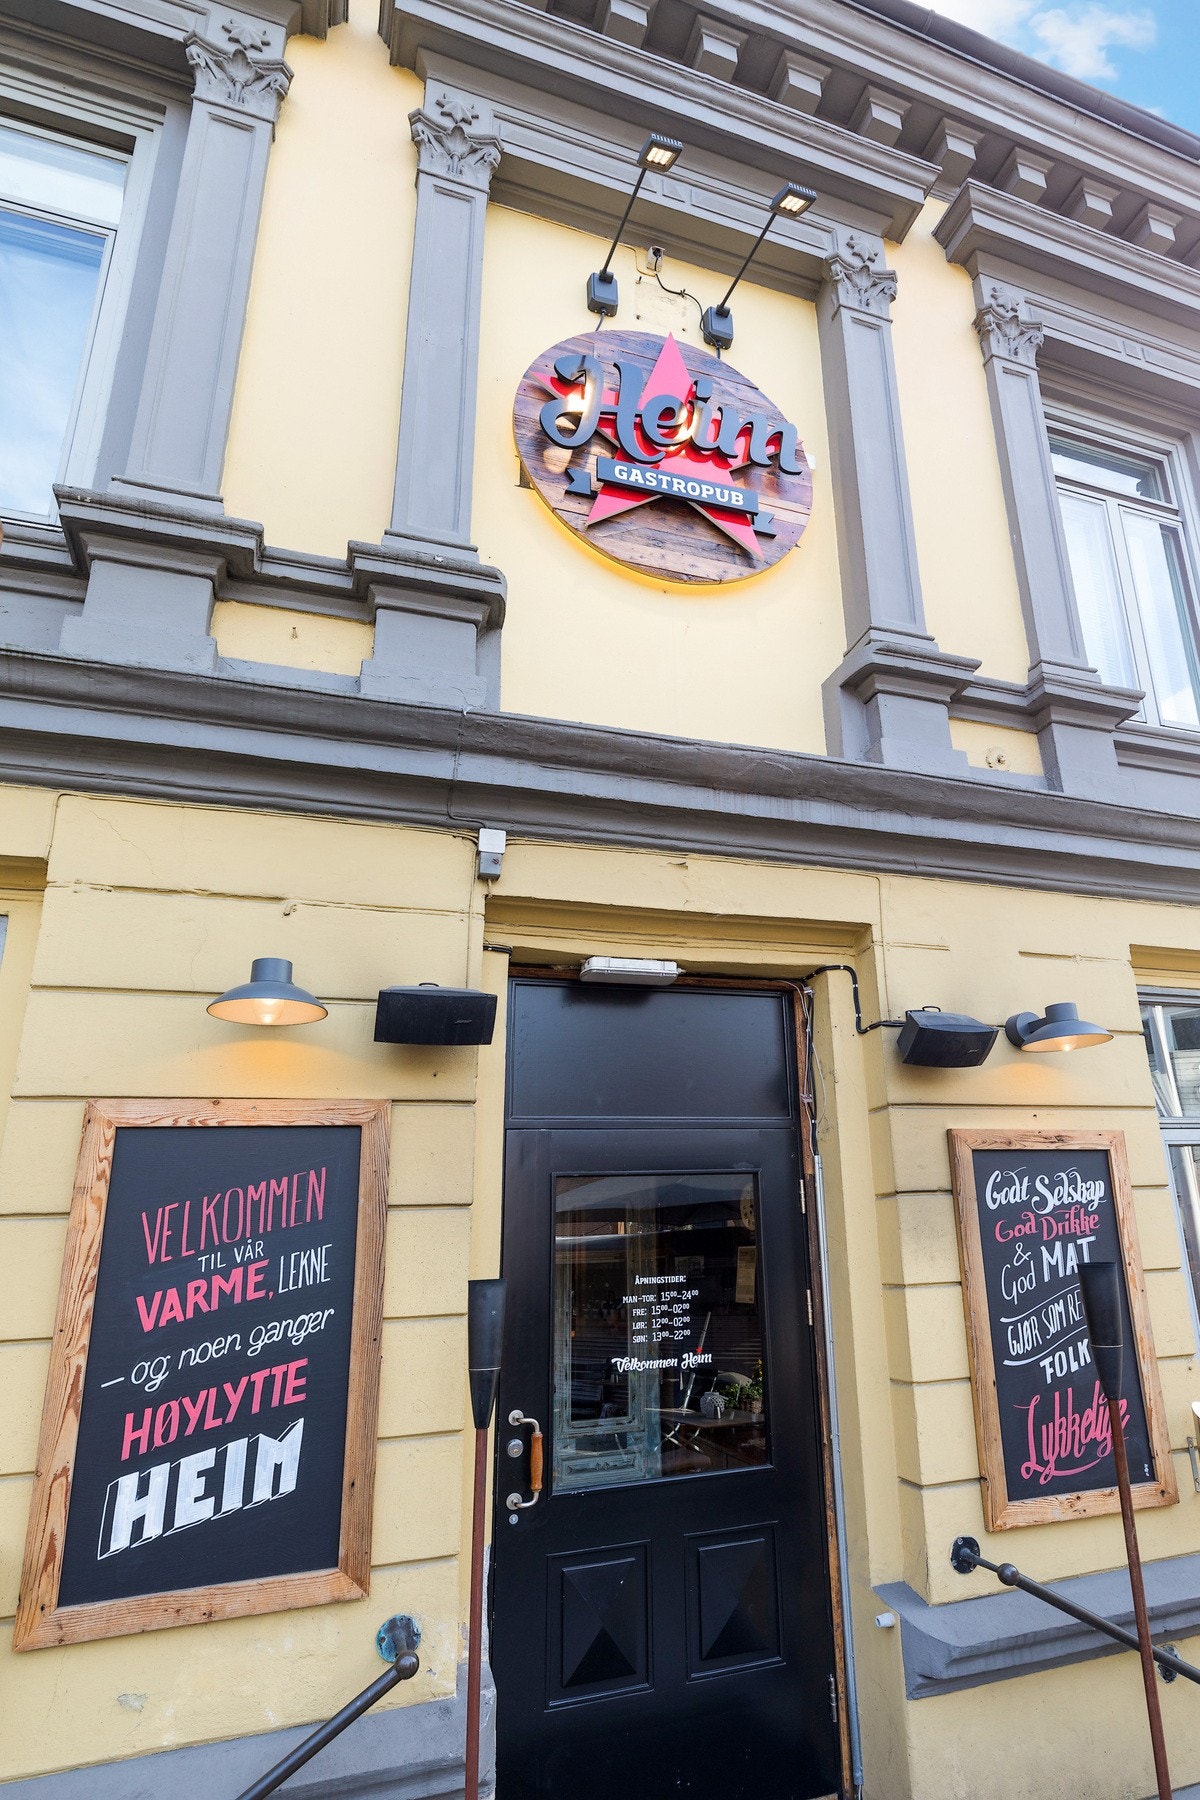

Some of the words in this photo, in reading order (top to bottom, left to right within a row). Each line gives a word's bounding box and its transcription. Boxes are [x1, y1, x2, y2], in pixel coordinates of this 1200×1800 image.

[539, 354, 803, 476] Heim
[614, 464, 745, 507] GASTROPUB
[141, 1167, 327, 1265] VELKOMMEN
[985, 1166, 1032, 1211] Godt
[1031, 1167, 1107, 1215] Selskap
[994, 1211, 1039, 1243] God
[1039, 1204, 1101, 1241] Drikke
[197, 1254, 227, 1272] TIL
[233, 1239, 265, 1264] VÅR
[634, 1274, 687, 1285] ÅPNINGSTIDER:
[1001, 1260, 1037, 1306] God
[1040, 1235, 1097, 1283] MAT
[136, 1259, 274, 1333] VARME,
[278, 1243, 333, 1294] LEKNE
[632, 1307, 648, 1317] FRE:
[130, 1354, 171, 1392] og
[177, 1333, 242, 1370] noen
[247, 1308, 335, 1357] ganger
[1007, 1317, 1043, 1357] GJØR
[1041, 1299, 1067, 1340] SOM
[610, 1356, 679, 1373] Velkommen
[680, 1351, 713, 1370] Heim
[1039, 1338, 1092, 1385] FOLK
[121, 1358, 309, 1462] HØYLYTTE
[97, 1417, 305, 1561] HEIM
